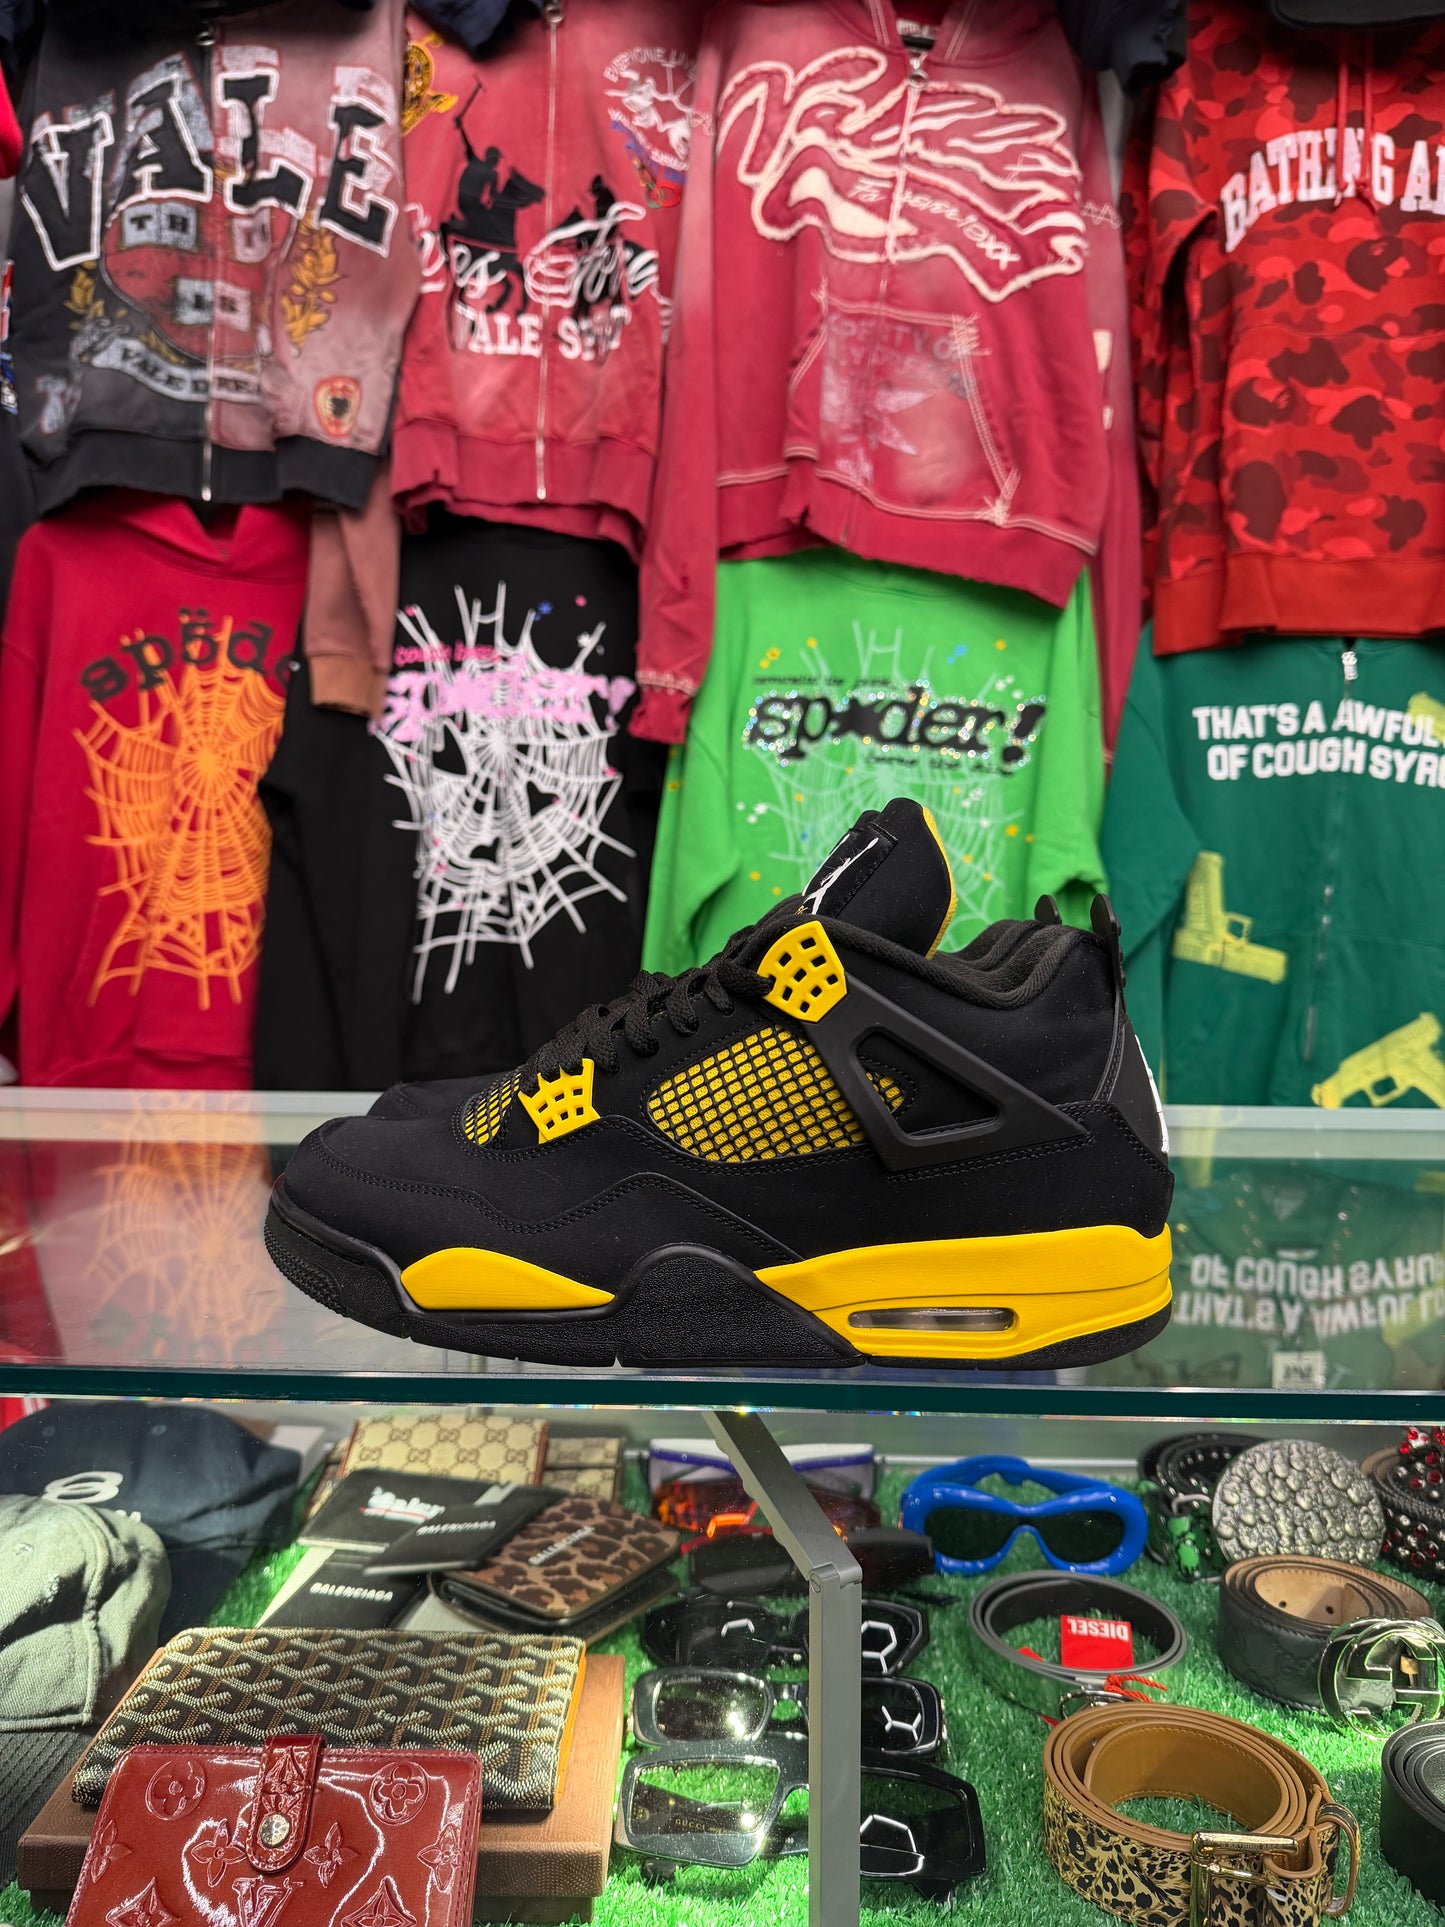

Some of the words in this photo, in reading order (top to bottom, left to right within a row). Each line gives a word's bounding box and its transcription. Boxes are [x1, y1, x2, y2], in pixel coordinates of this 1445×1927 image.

[20, 52, 398, 271] VALE
[1220, 127, 1395, 253] BATHING
[1192, 704, 1299, 739] THAT'S
[1302, 700, 1326, 734] A
[1332, 698, 1441, 748] AWFUL
[1207, 745, 1249, 780] OF
[1252, 737, 1368, 779] COUGH
[309, 1582, 393, 1602] BALENCIAGA
[1067, 1618, 1129, 1643] DIESEL
